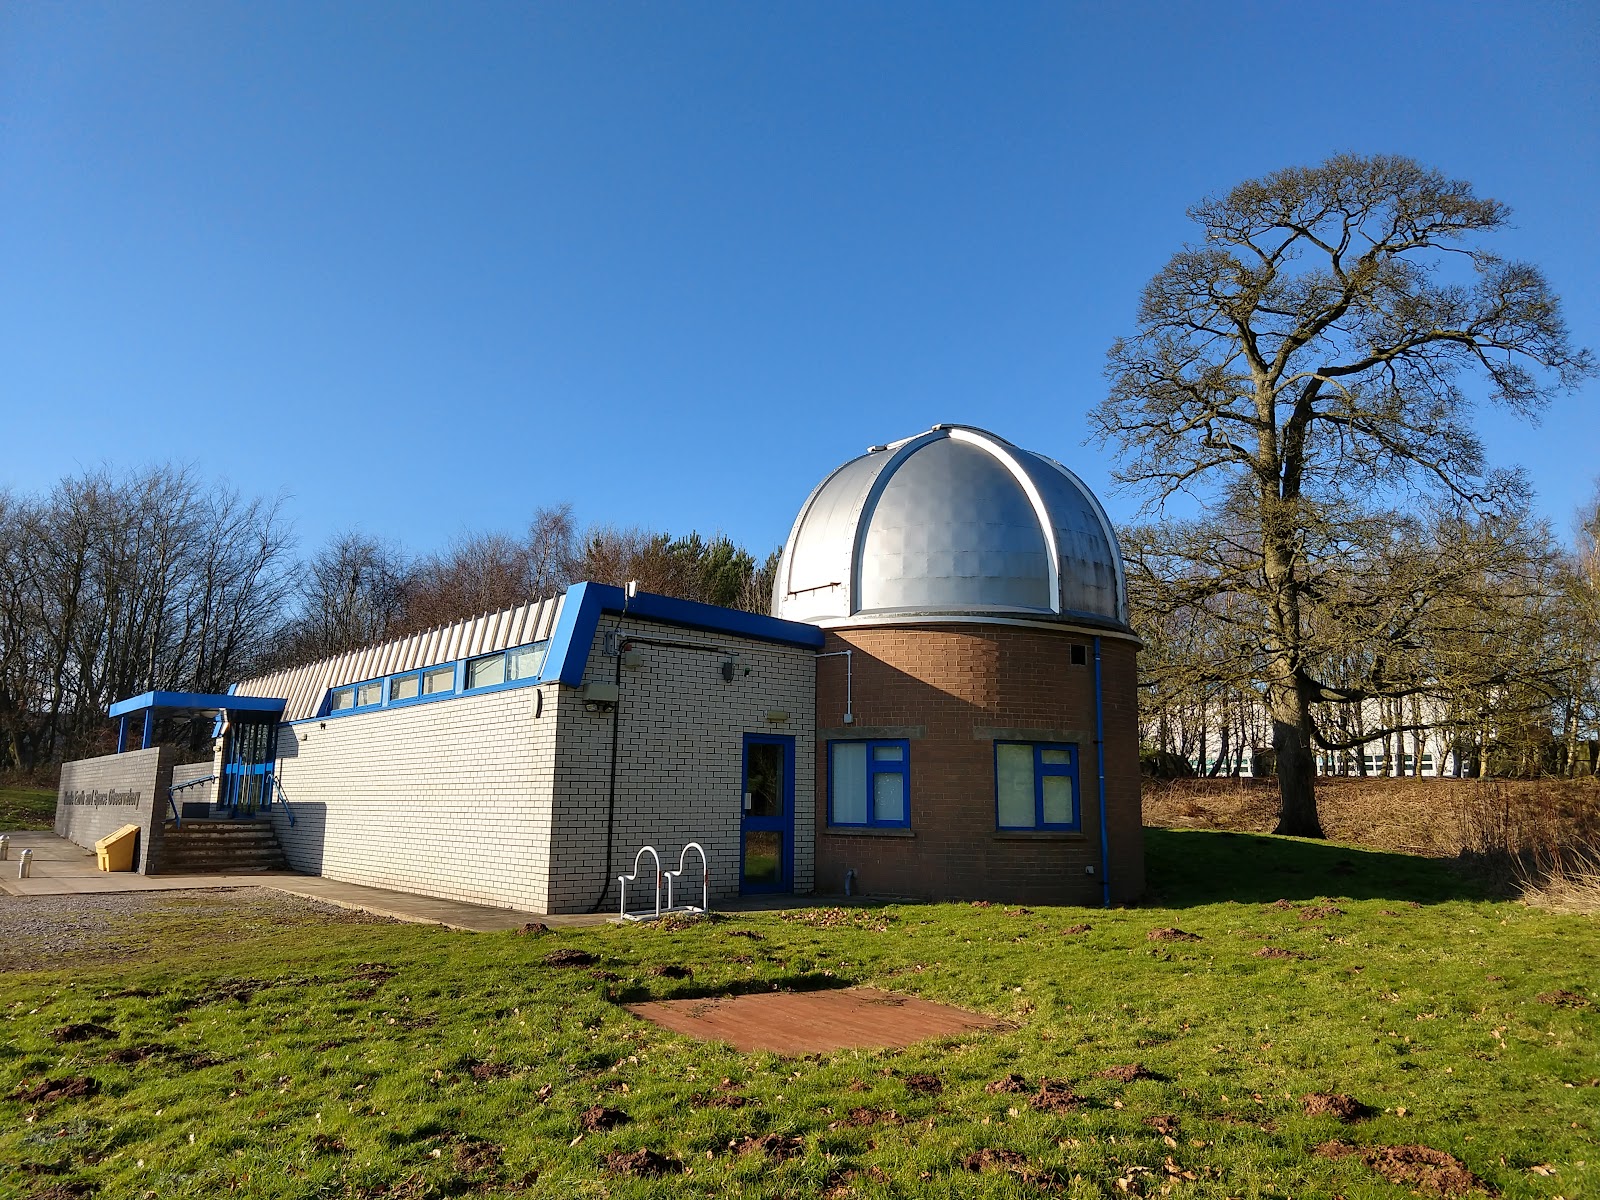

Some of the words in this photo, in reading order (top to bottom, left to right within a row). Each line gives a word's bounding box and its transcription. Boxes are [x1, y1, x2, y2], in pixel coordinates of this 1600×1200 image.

[85, 789, 94, 805] and
[94, 789, 107, 809] Space
[108, 788, 141, 810] Observatory
